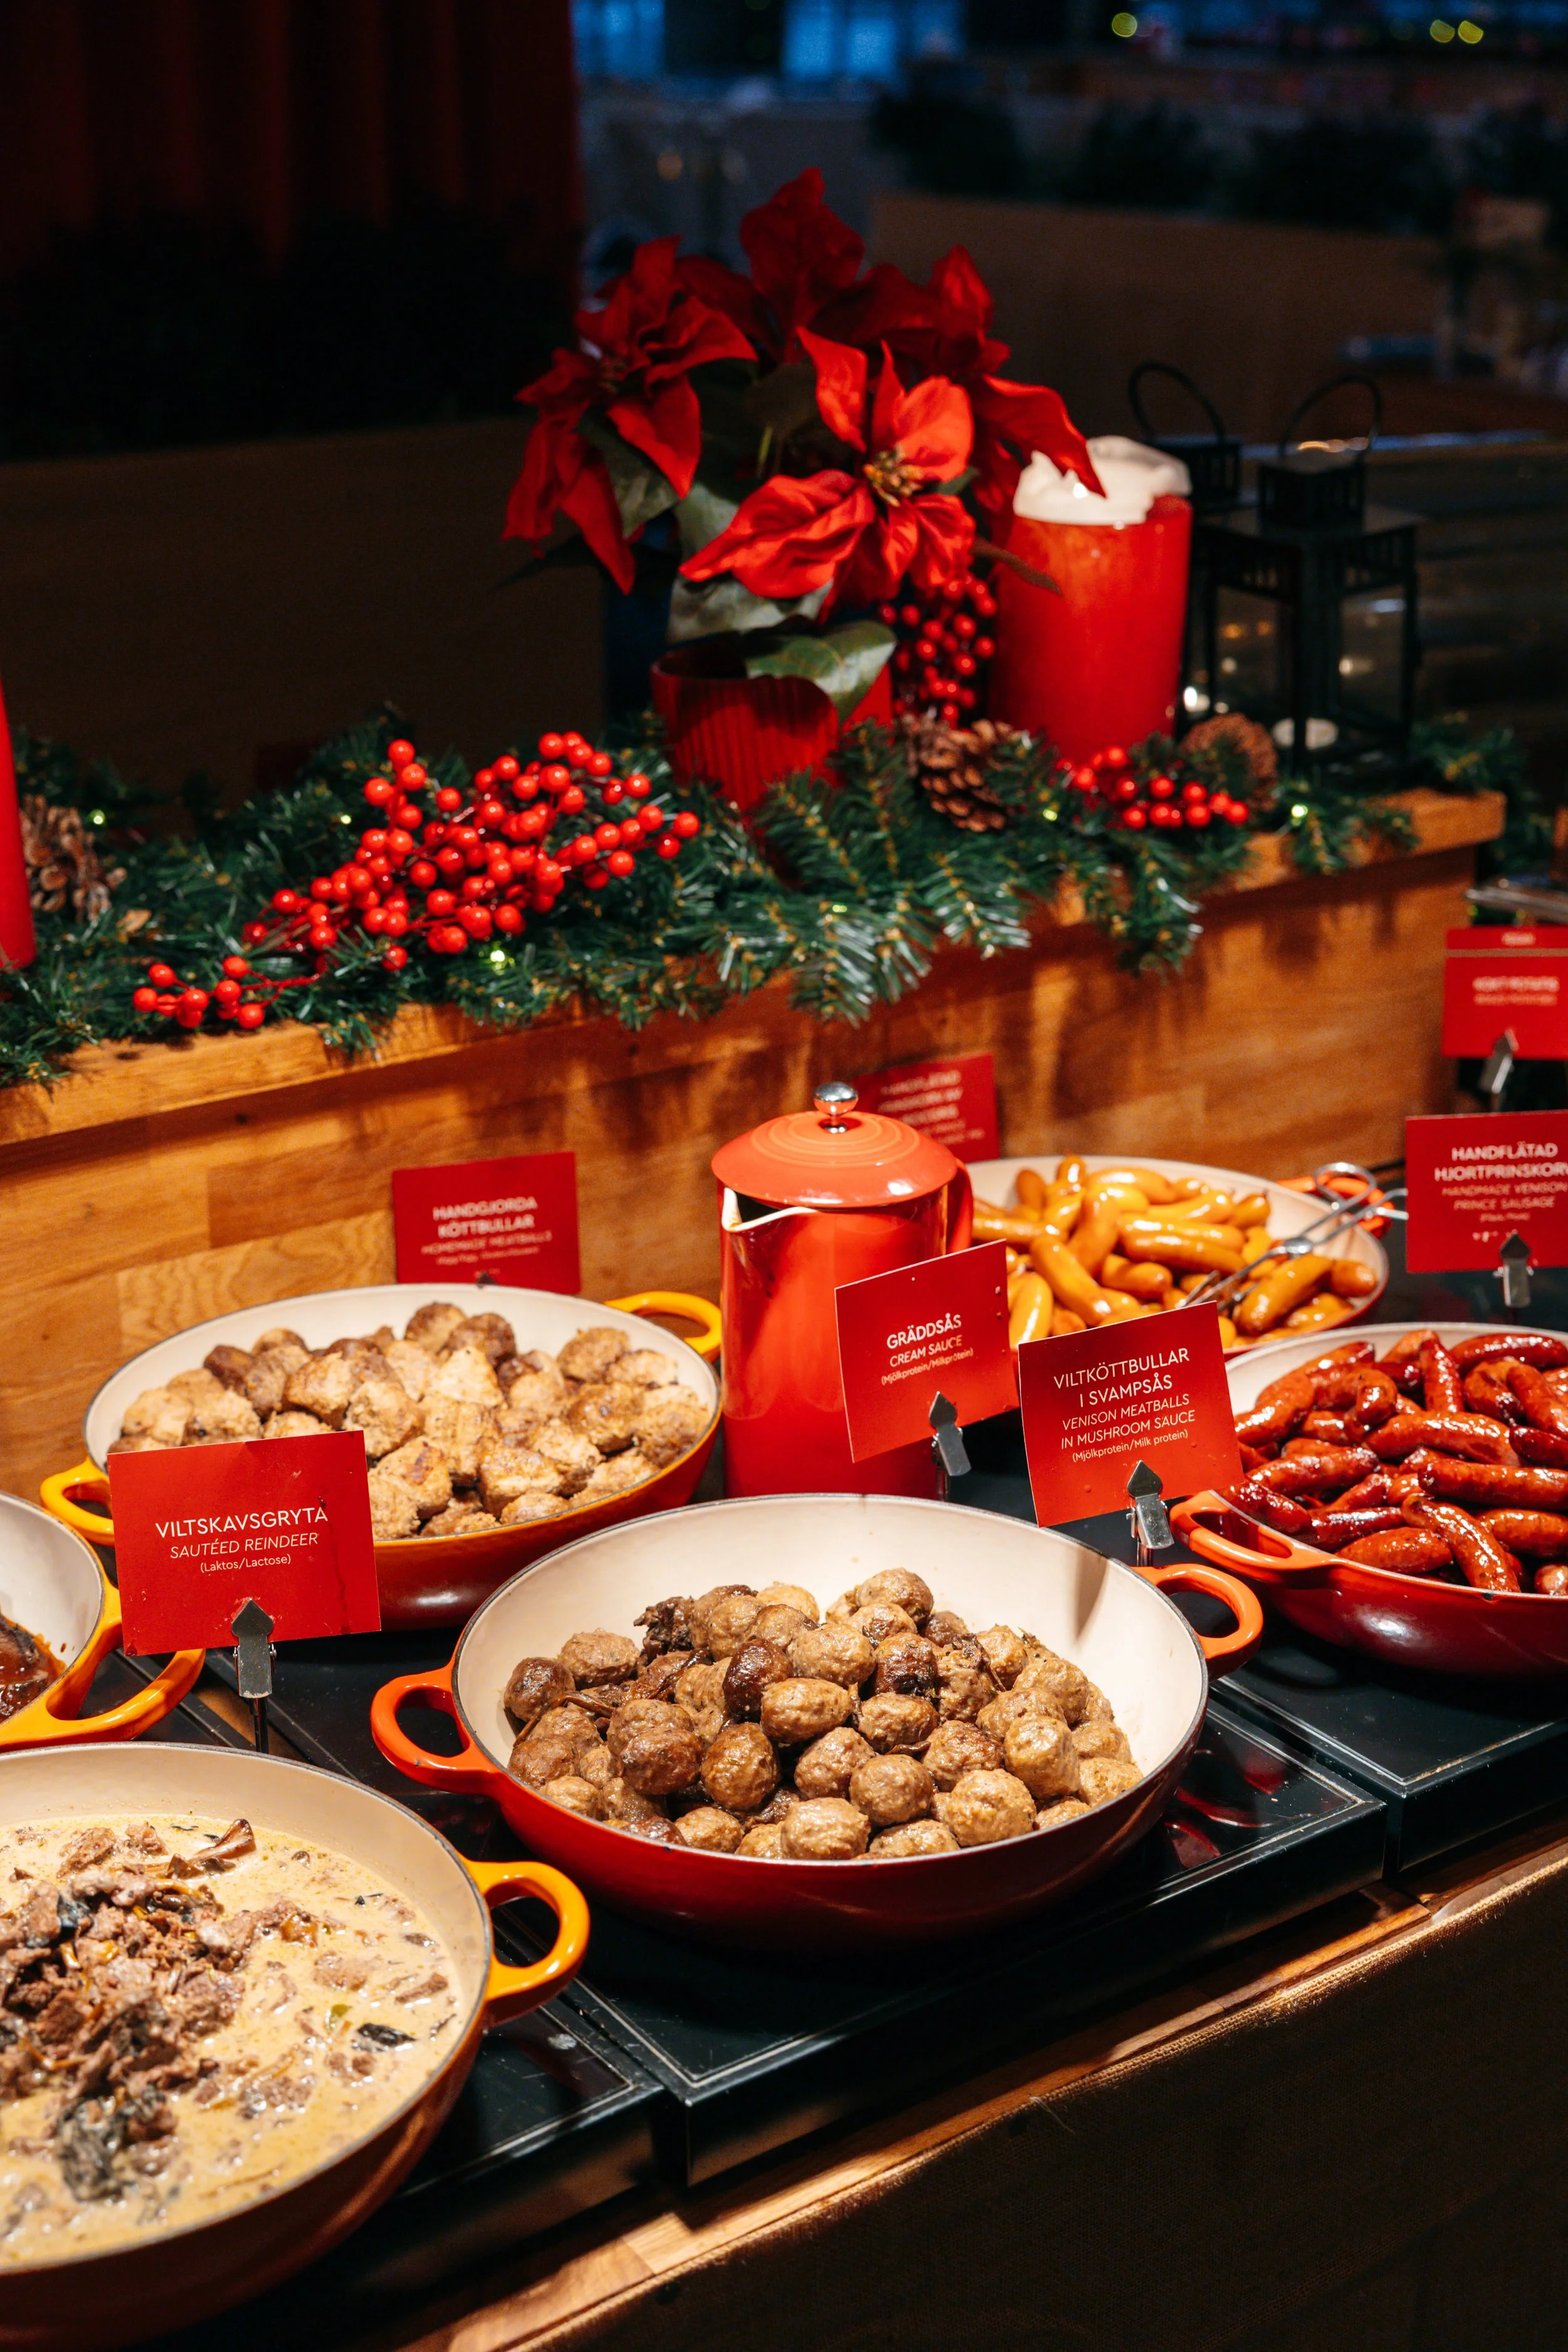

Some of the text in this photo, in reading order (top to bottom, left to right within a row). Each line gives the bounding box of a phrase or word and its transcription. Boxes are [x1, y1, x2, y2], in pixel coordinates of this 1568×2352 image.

[432, 1196, 538, 1221] HANDGJORDA
[438, 1214, 535, 1239] KÖTTBULLAR
[886, 1313, 962, 1349] GRÄDDSÅS
[889, 1335, 963, 1367] CREAM SAUCE
[1054, 1348, 1190, 1389] VILTKÖTTBULLAR
[1079, 1372, 1173, 1407] I SVAMPSÅS
[1062, 1393, 1190, 1431] VENISON MEATBALLS
[1061, 1409, 1195, 1449] IN MUSHROOM SAUCE
[1072, 1429, 1189, 1463] (Mjölkprotein/Milk protein)
[155, 1507, 328, 1539] VILTSKAVSGRYTA
[170, 1532, 319, 1559] SAUTÉED REINDEER
[200, 1554, 292, 1574] (Laktos/Lactose)
